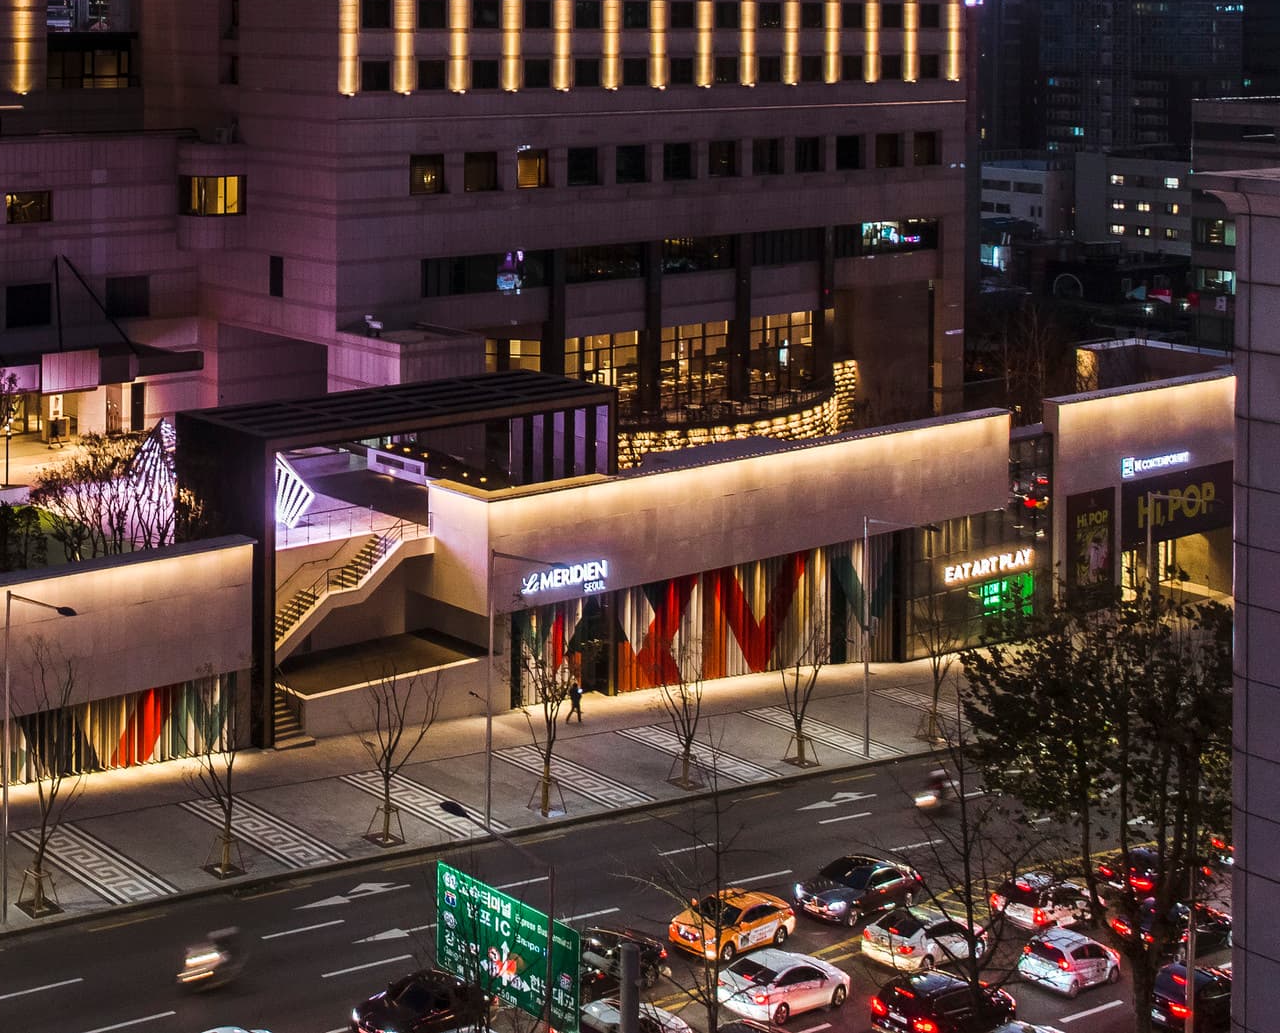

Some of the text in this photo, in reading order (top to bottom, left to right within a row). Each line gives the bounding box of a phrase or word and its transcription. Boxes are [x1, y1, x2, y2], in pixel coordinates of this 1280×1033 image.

[521, 559, 608, 595] Le MERIDIEN
[944, 548, 1034, 583] EAT ART PLAY
[583, 580, 606, 593] SEOUL
[458, 879, 512, 919] 고속터미널
[495, 916, 511, 937] IC
[515, 913, 536, 931] Epress
